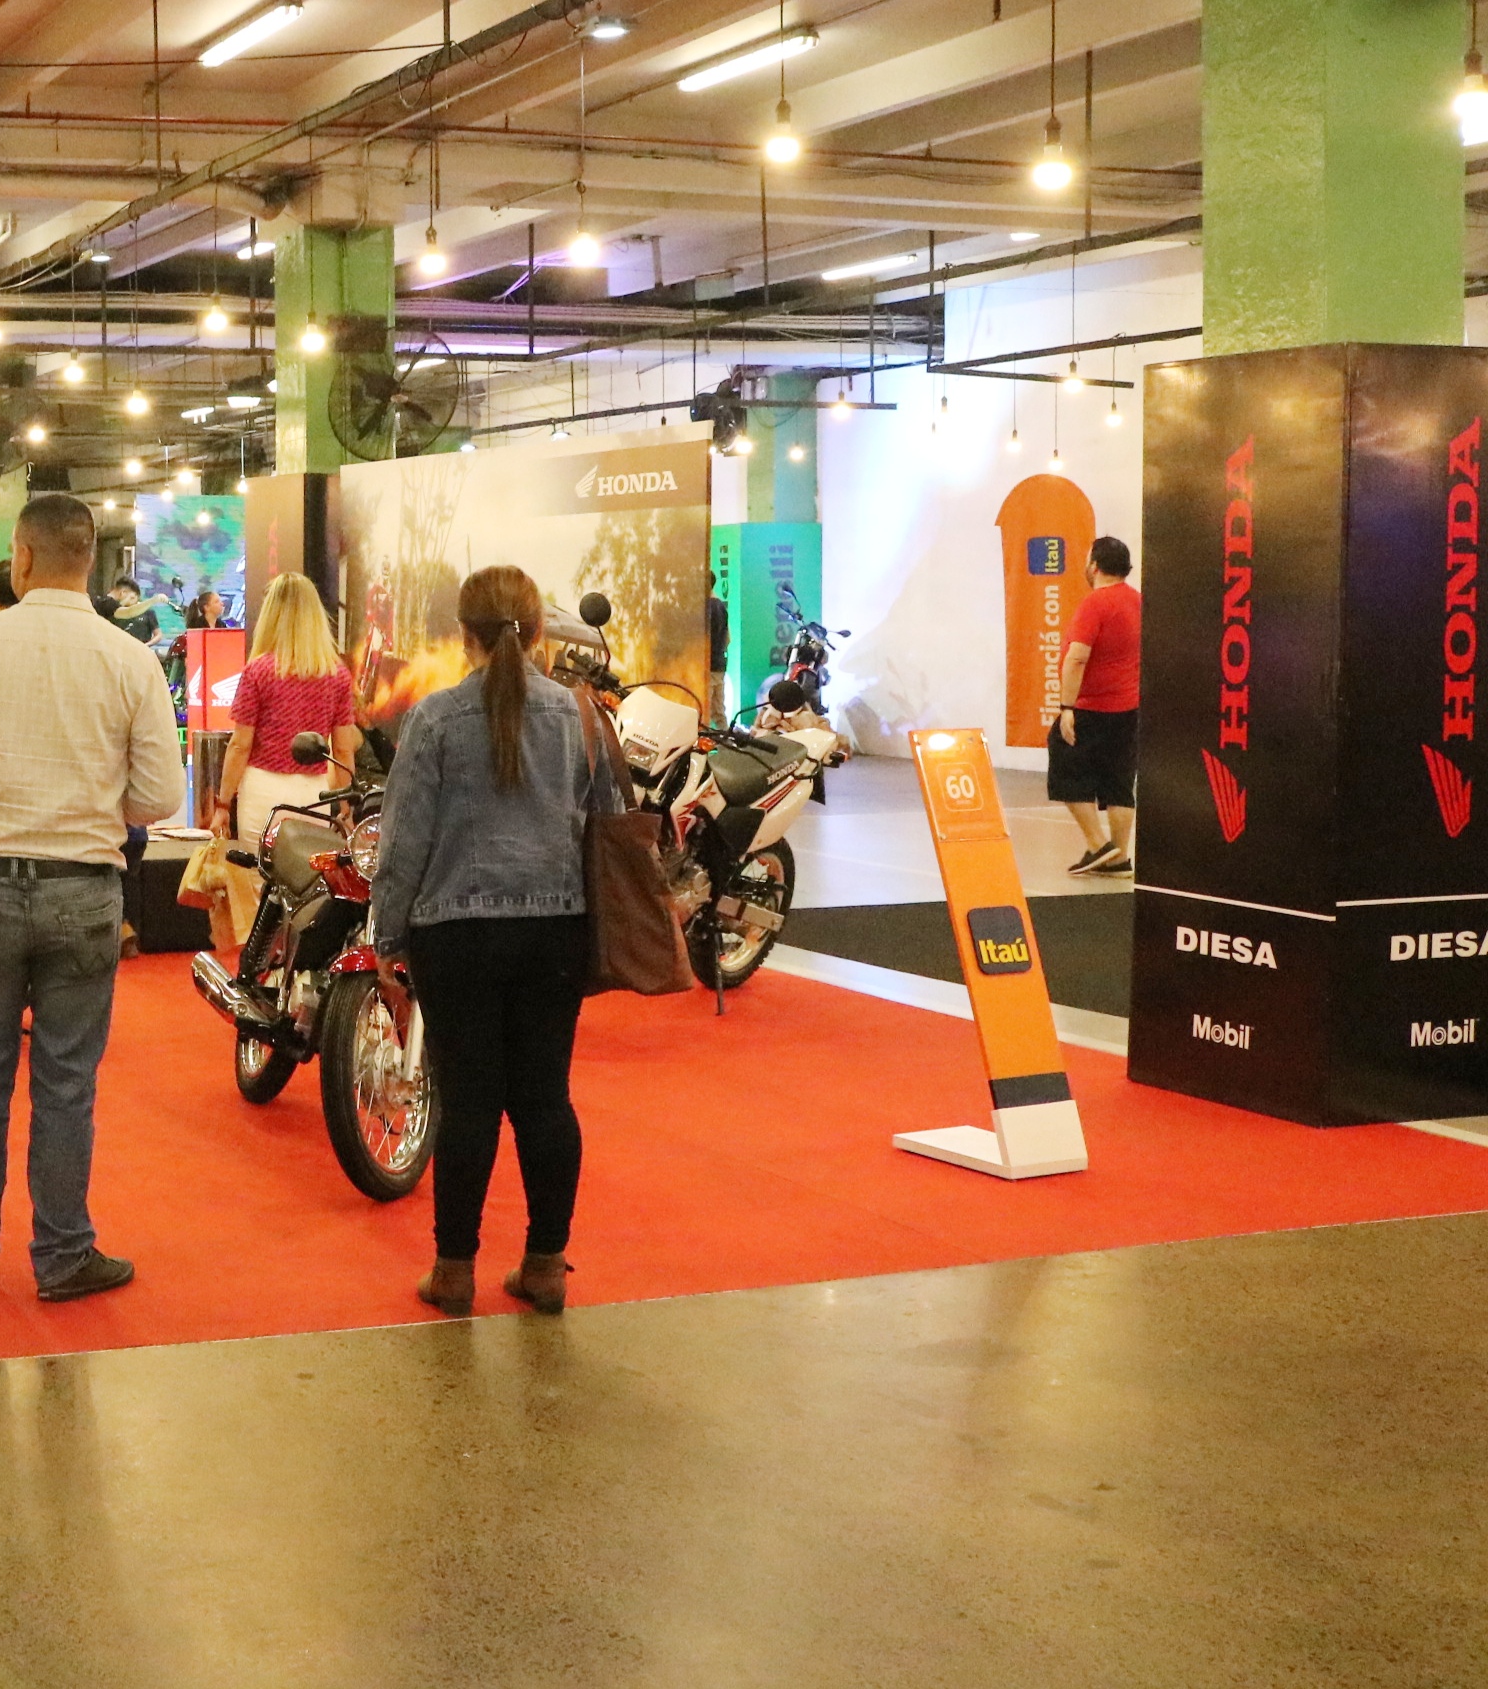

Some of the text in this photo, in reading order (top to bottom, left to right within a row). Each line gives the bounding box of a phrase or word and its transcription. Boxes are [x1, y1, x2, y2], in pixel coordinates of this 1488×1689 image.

[597, 470, 678, 497] HONDA
[1045, 539, 1059, 573] Itaú
[1218, 434, 1255, 750] HONDA
[1441, 417, 1481, 742] HONDA
[769, 544, 794, 667] Benelli
[1039, 585, 1061, 727] Financiá con
[766, 760, 800, 785] HONDA
[945, 775, 975, 799] 60
[978, 937, 1029, 964] Itaú
[1176, 926, 1278, 969] DIESA
[1192, 1013, 1252, 1050] Mobil
[1410, 1018, 1476, 1048] Mobil
